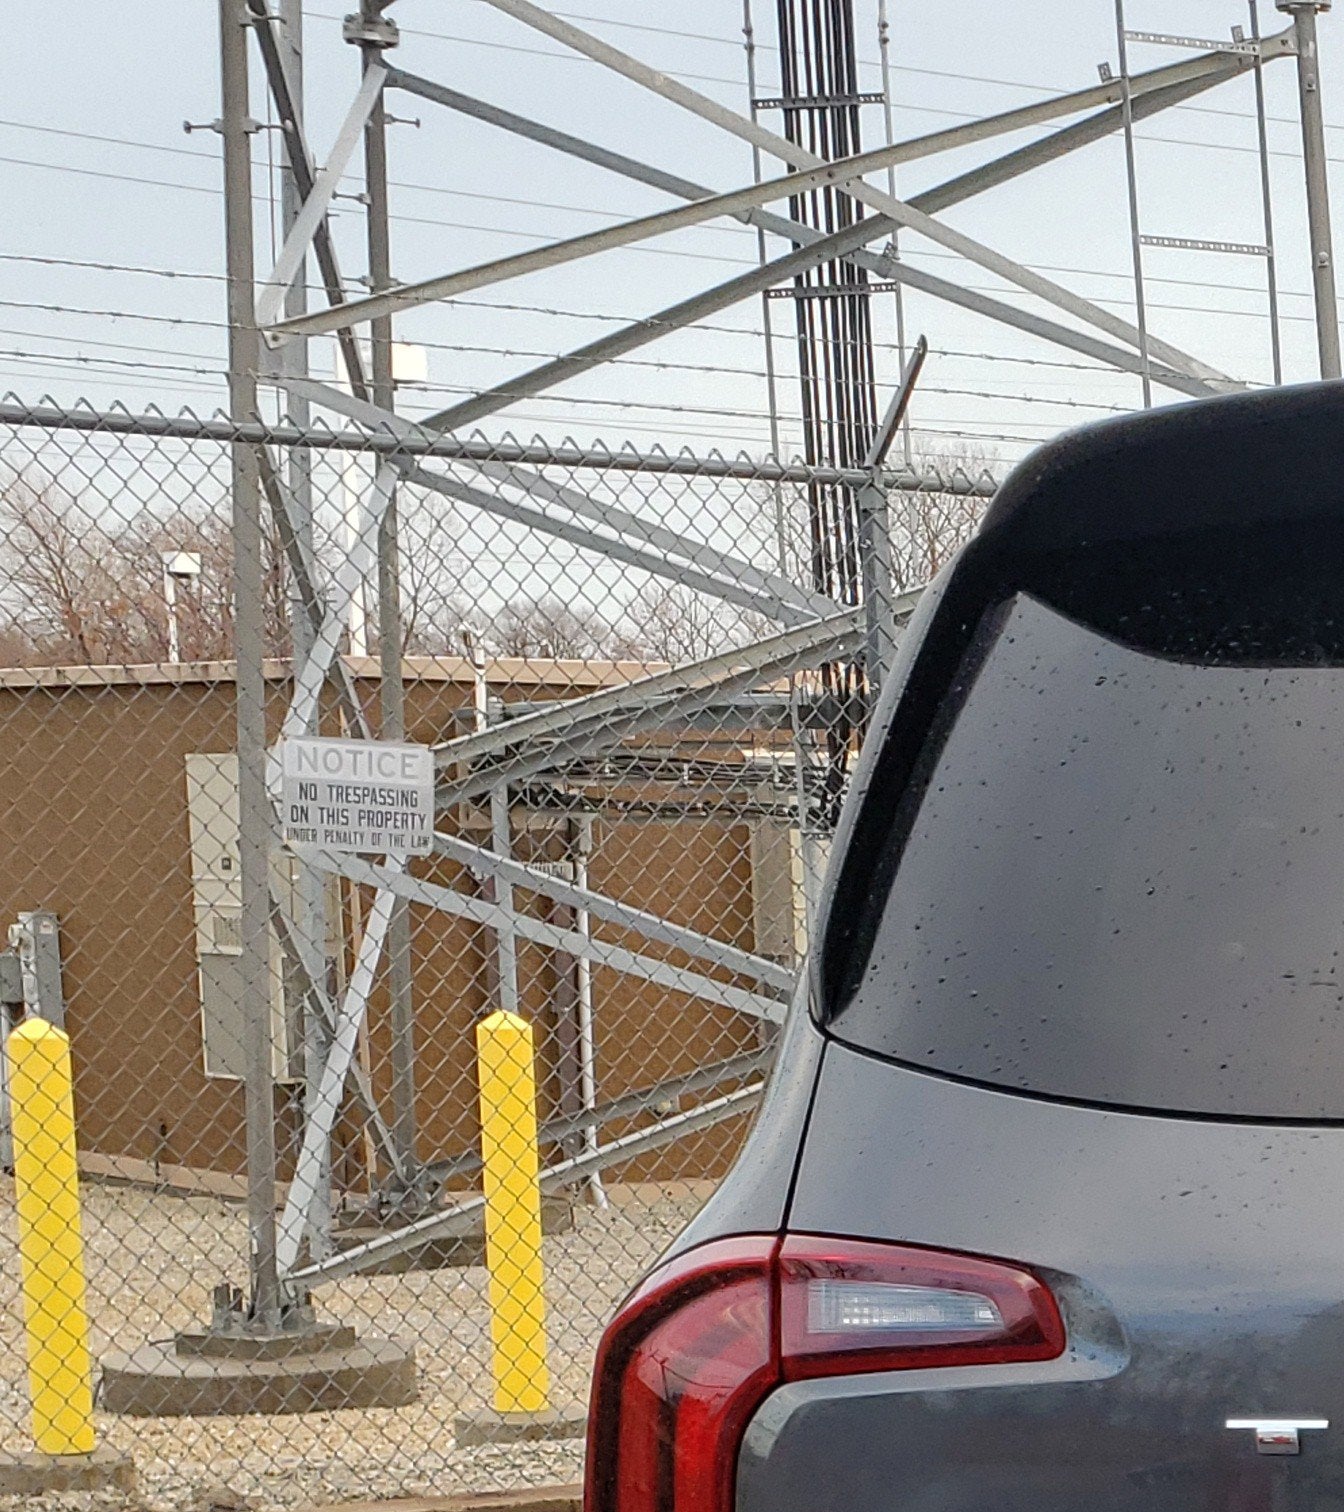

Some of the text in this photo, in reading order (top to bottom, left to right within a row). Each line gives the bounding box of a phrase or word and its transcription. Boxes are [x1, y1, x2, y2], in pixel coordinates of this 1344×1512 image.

[297, 745, 420, 780] NOTICE
[299, 782, 418, 808] NO TRESPASSING
[290, 805, 427, 831] ON THIS PROPERTY
[286, 827, 430, 849] UNDER PENALTY OF THE LAW
